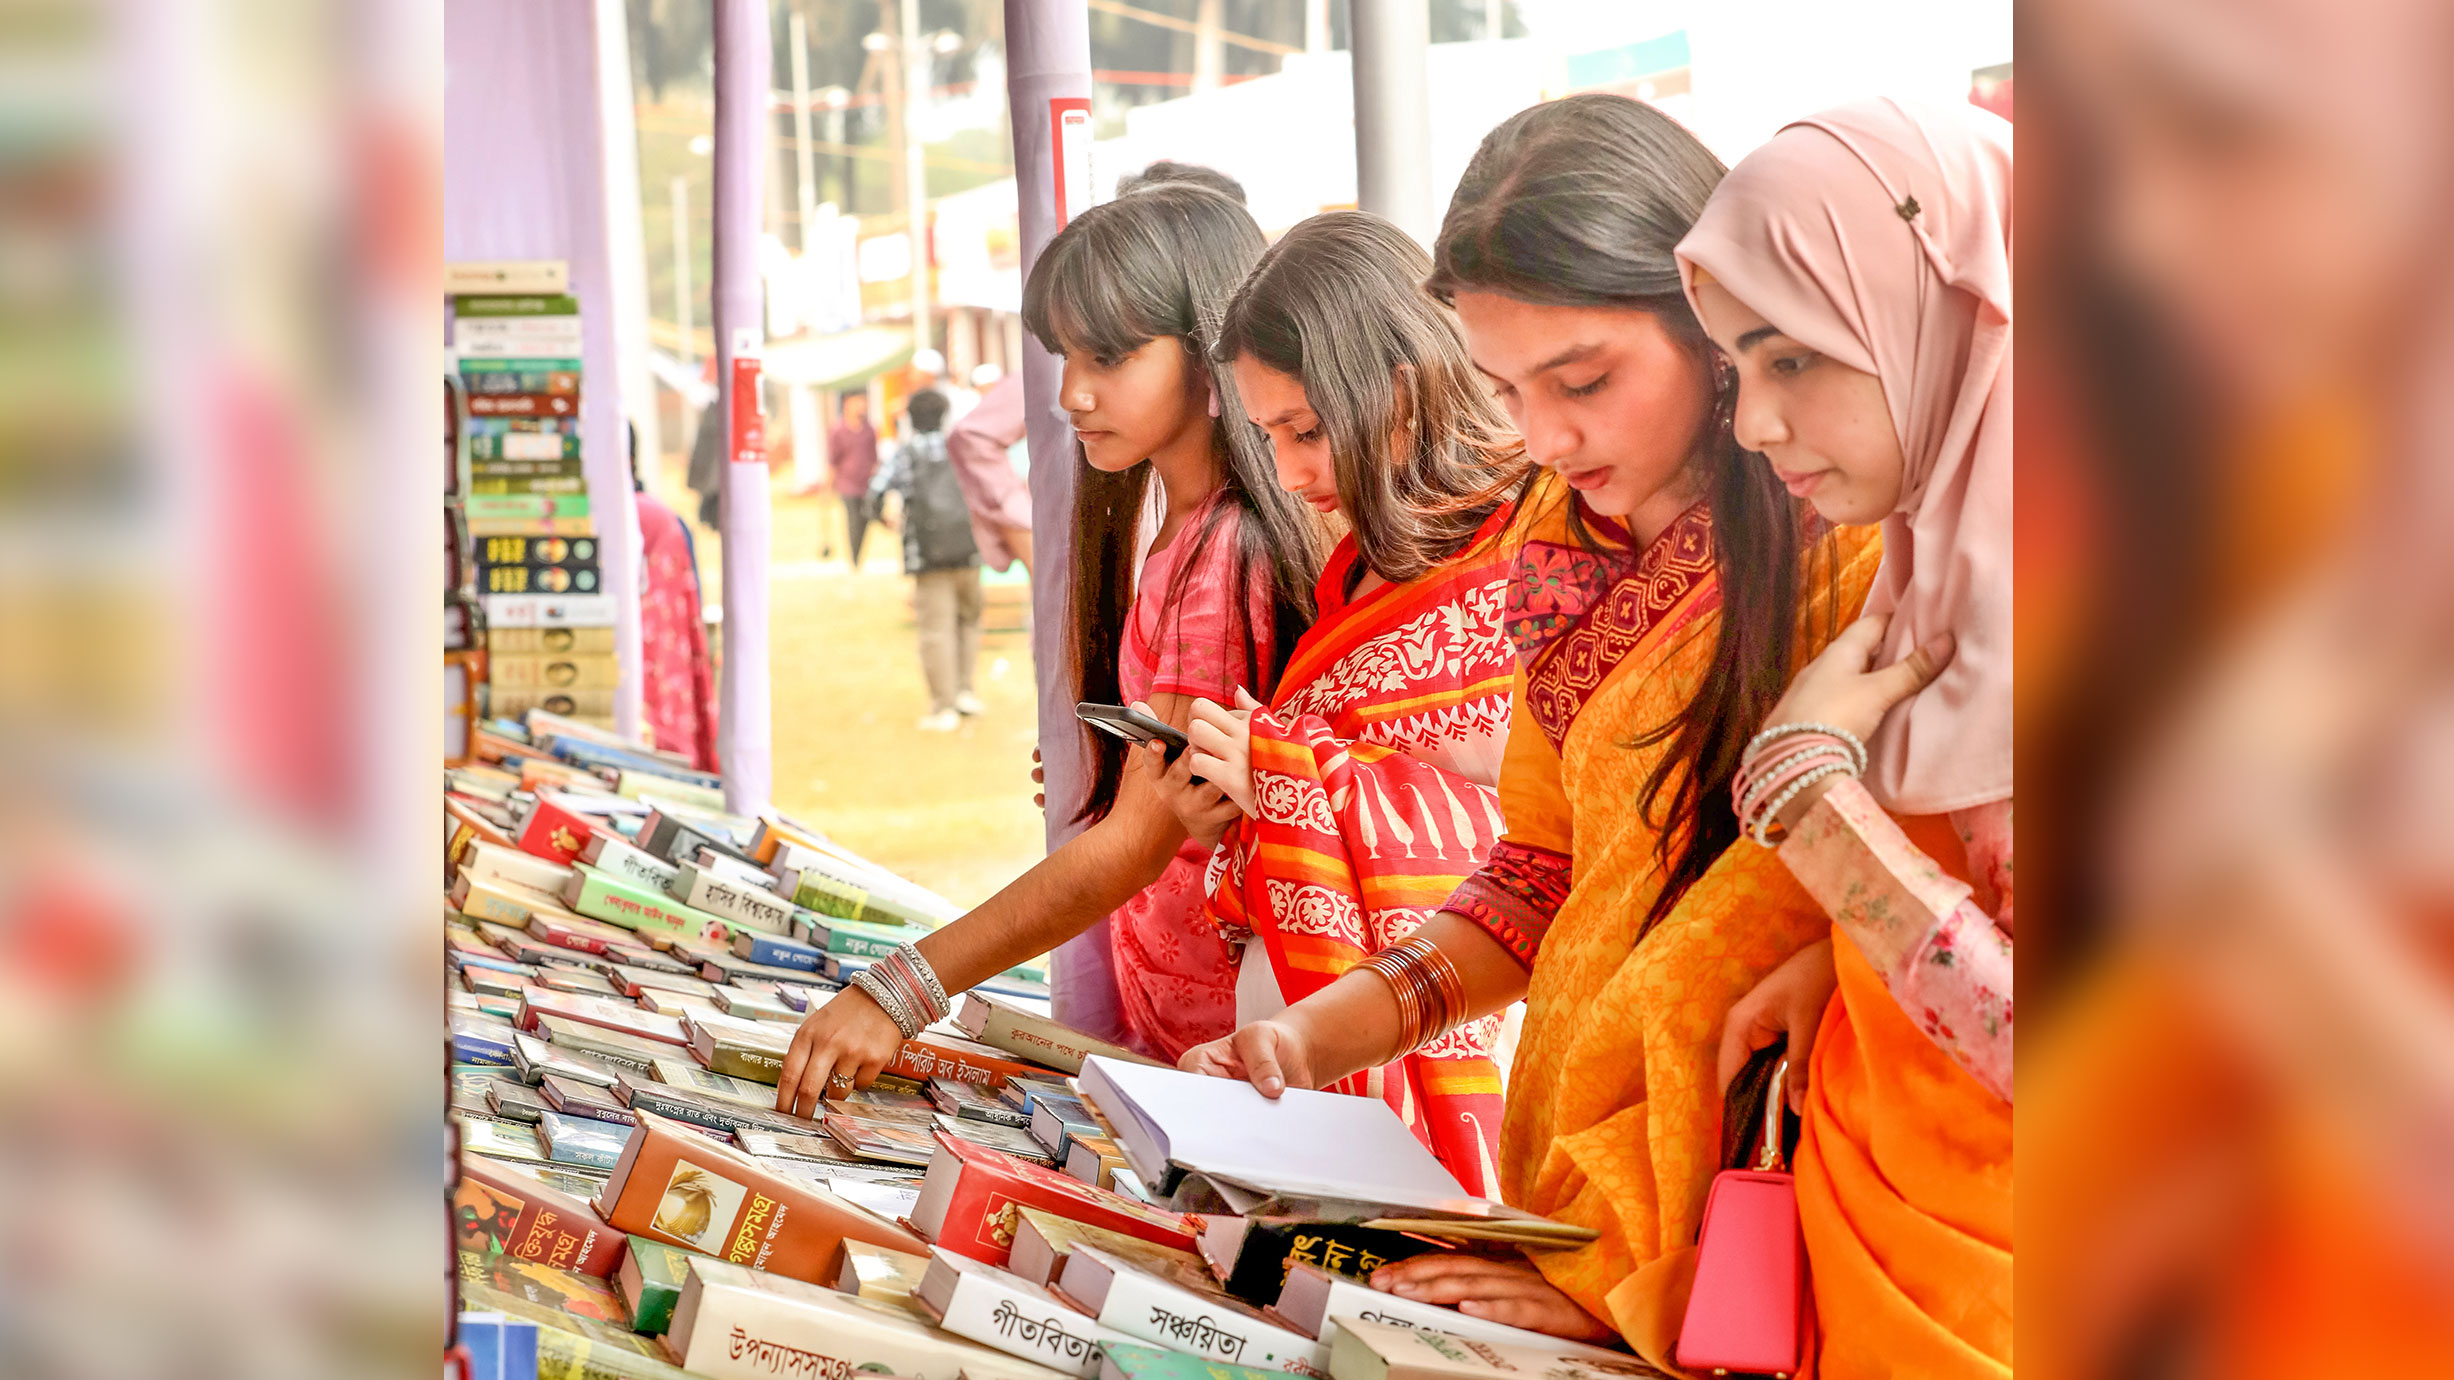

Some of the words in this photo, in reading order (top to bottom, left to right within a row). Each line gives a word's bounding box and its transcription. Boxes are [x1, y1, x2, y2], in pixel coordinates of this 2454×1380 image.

[624, 854, 674, 889] গীতবিত
[740, 1052, 762, 1064] বাংলার
[1011, 1028, 1053, 1049] কুরআনের
[1056, 1043, 1076, 1057] পথে
[899, 1043, 936, 1073] স্পিরিট
[938, 1059, 955, 1079] অব
[957, 1057, 991, 1086] ইসলাম
[686, 1108, 700, 1119] রাত
[702, 1112, 717, 1124] এবং
[514, 1207, 558, 1258] ক্তিযুদ্ধ
[729, 1192, 776, 1263] গল্পসমগ্র
[766, 1203, 789, 1240] আহমেদ
[576, 1228, 598, 1265] আহমেদ
[730, 1323, 853, 1380] উপন্যাসসমগ্র
[993, 1299, 1102, 1366] গীতবিতান
[1150, 1306, 1248, 1363] সঞ্চয়িতা
